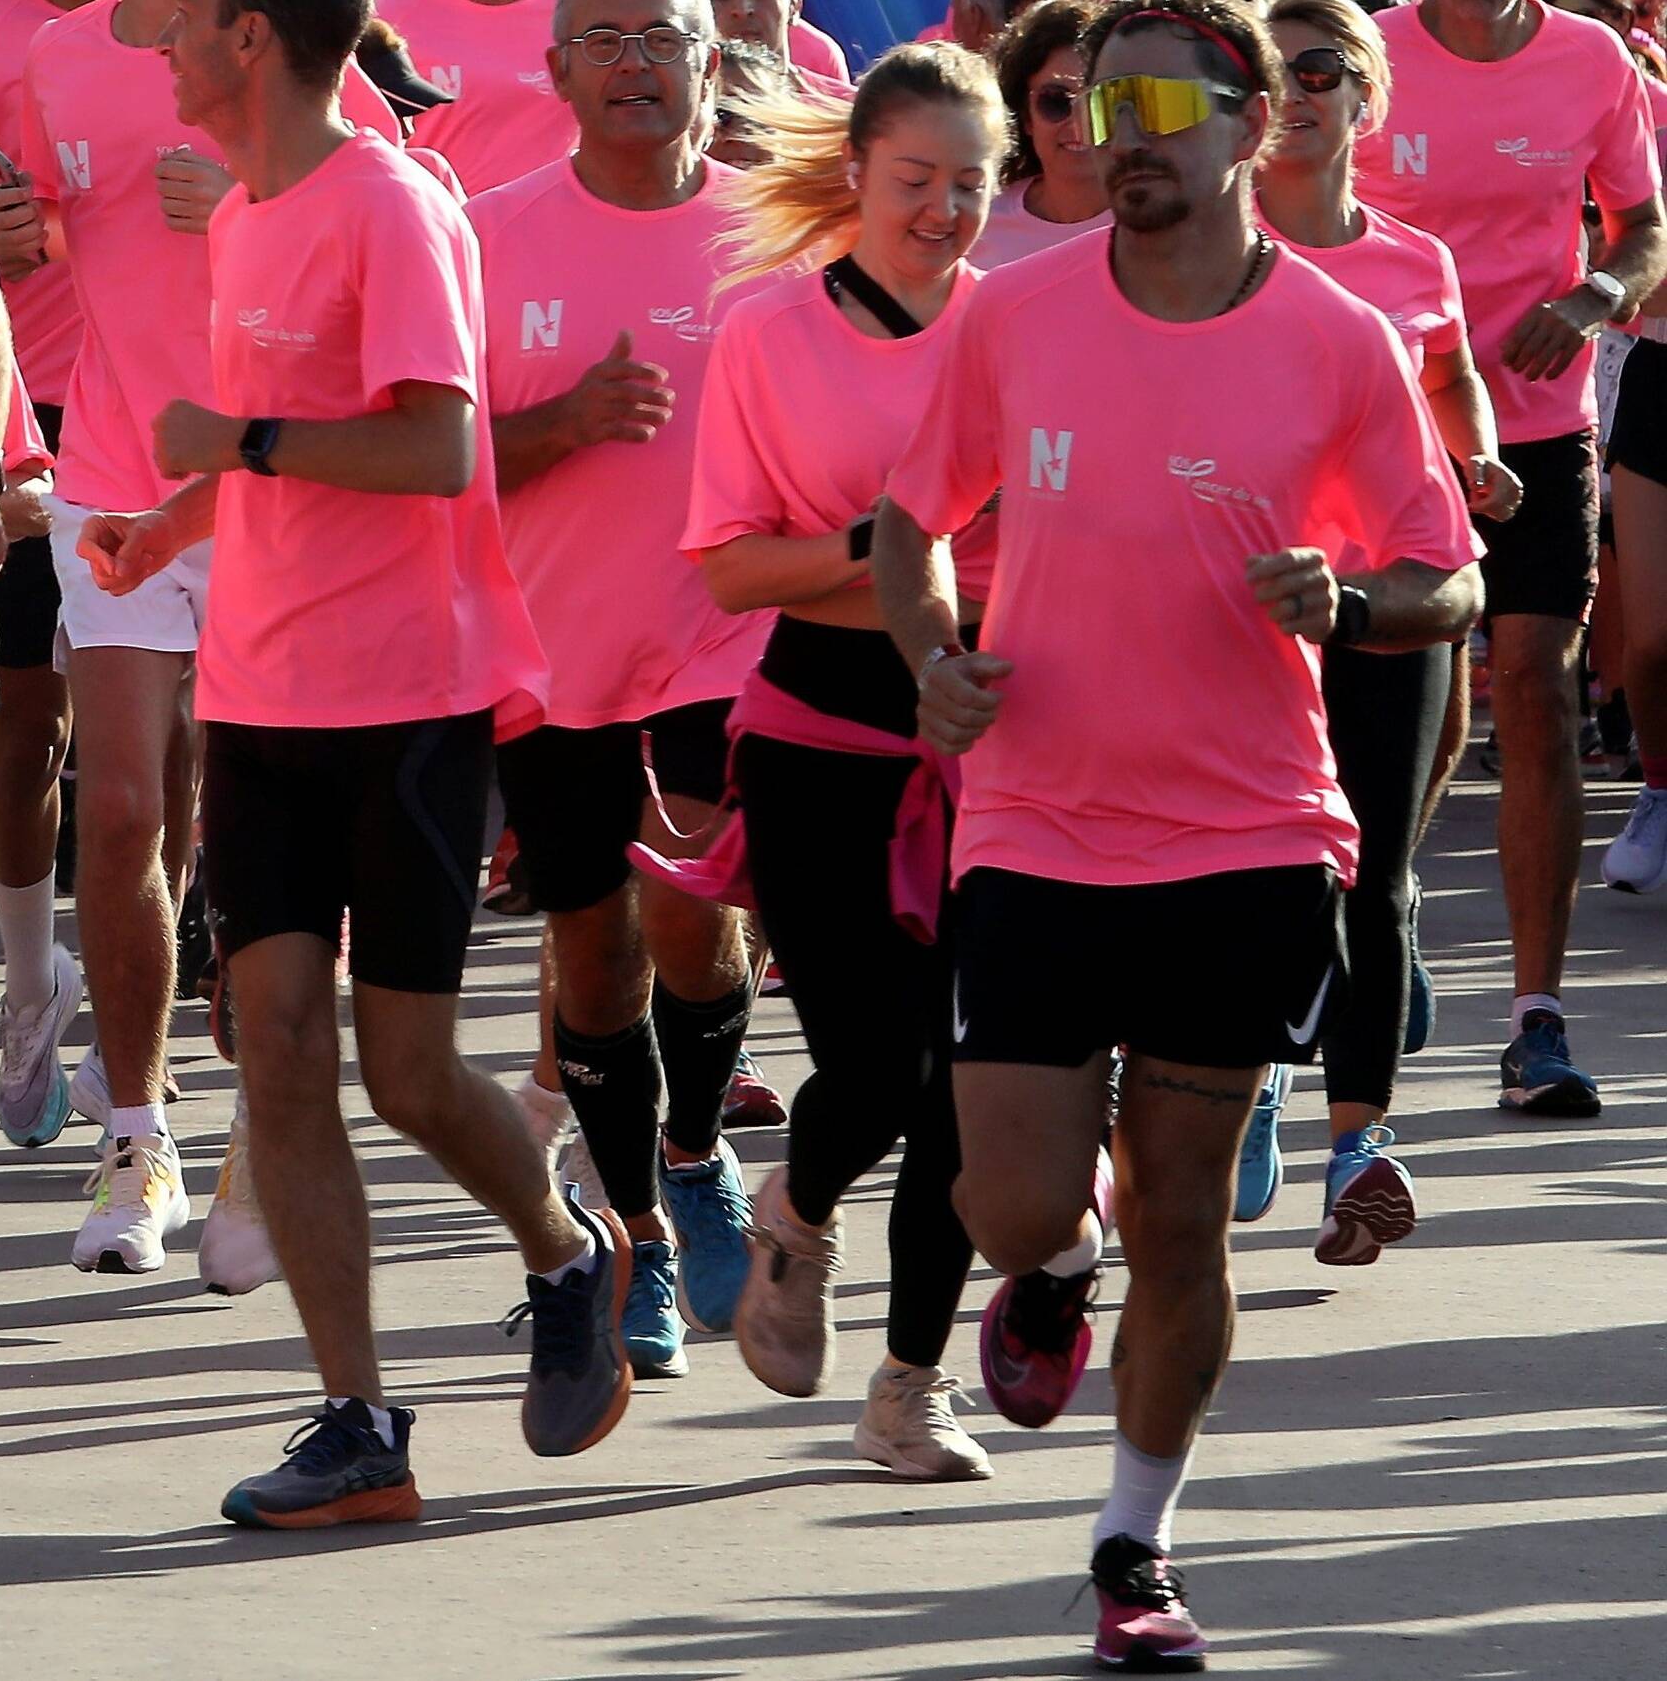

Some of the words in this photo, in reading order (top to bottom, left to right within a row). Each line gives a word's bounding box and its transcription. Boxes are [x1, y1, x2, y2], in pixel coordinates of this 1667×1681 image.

[56, 140, 91, 189] N
[1393, 133, 1427, 175] N
[521, 299, 563, 350] N
[1029, 427, 1074, 491] N
